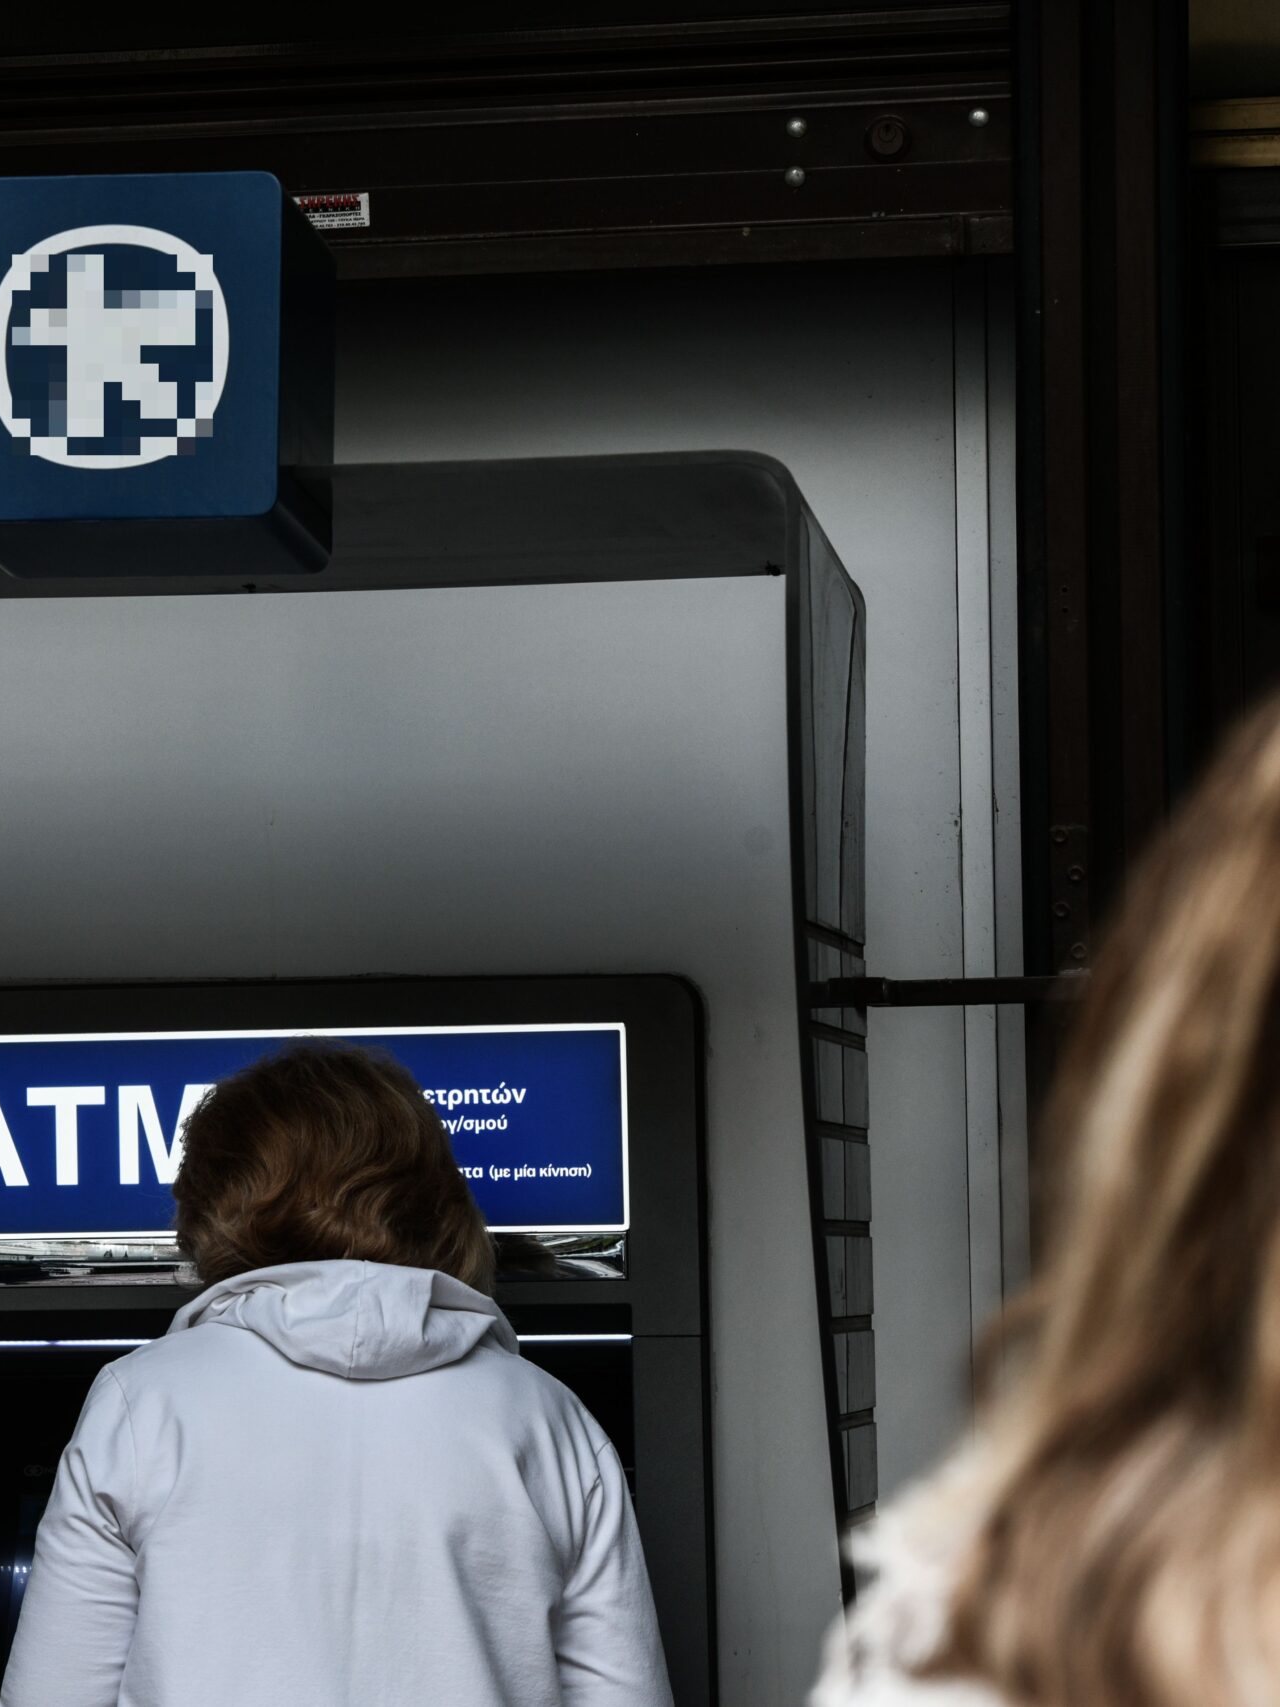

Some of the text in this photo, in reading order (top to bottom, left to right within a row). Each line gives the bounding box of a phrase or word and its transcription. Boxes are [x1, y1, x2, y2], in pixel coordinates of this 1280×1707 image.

[421, 1081, 527, 1111] ετρητών
[489, 1165, 511, 1181] (με
[514, 1163, 536, 1181] μία
[539, 1163, 592, 1179] κίνηση)
